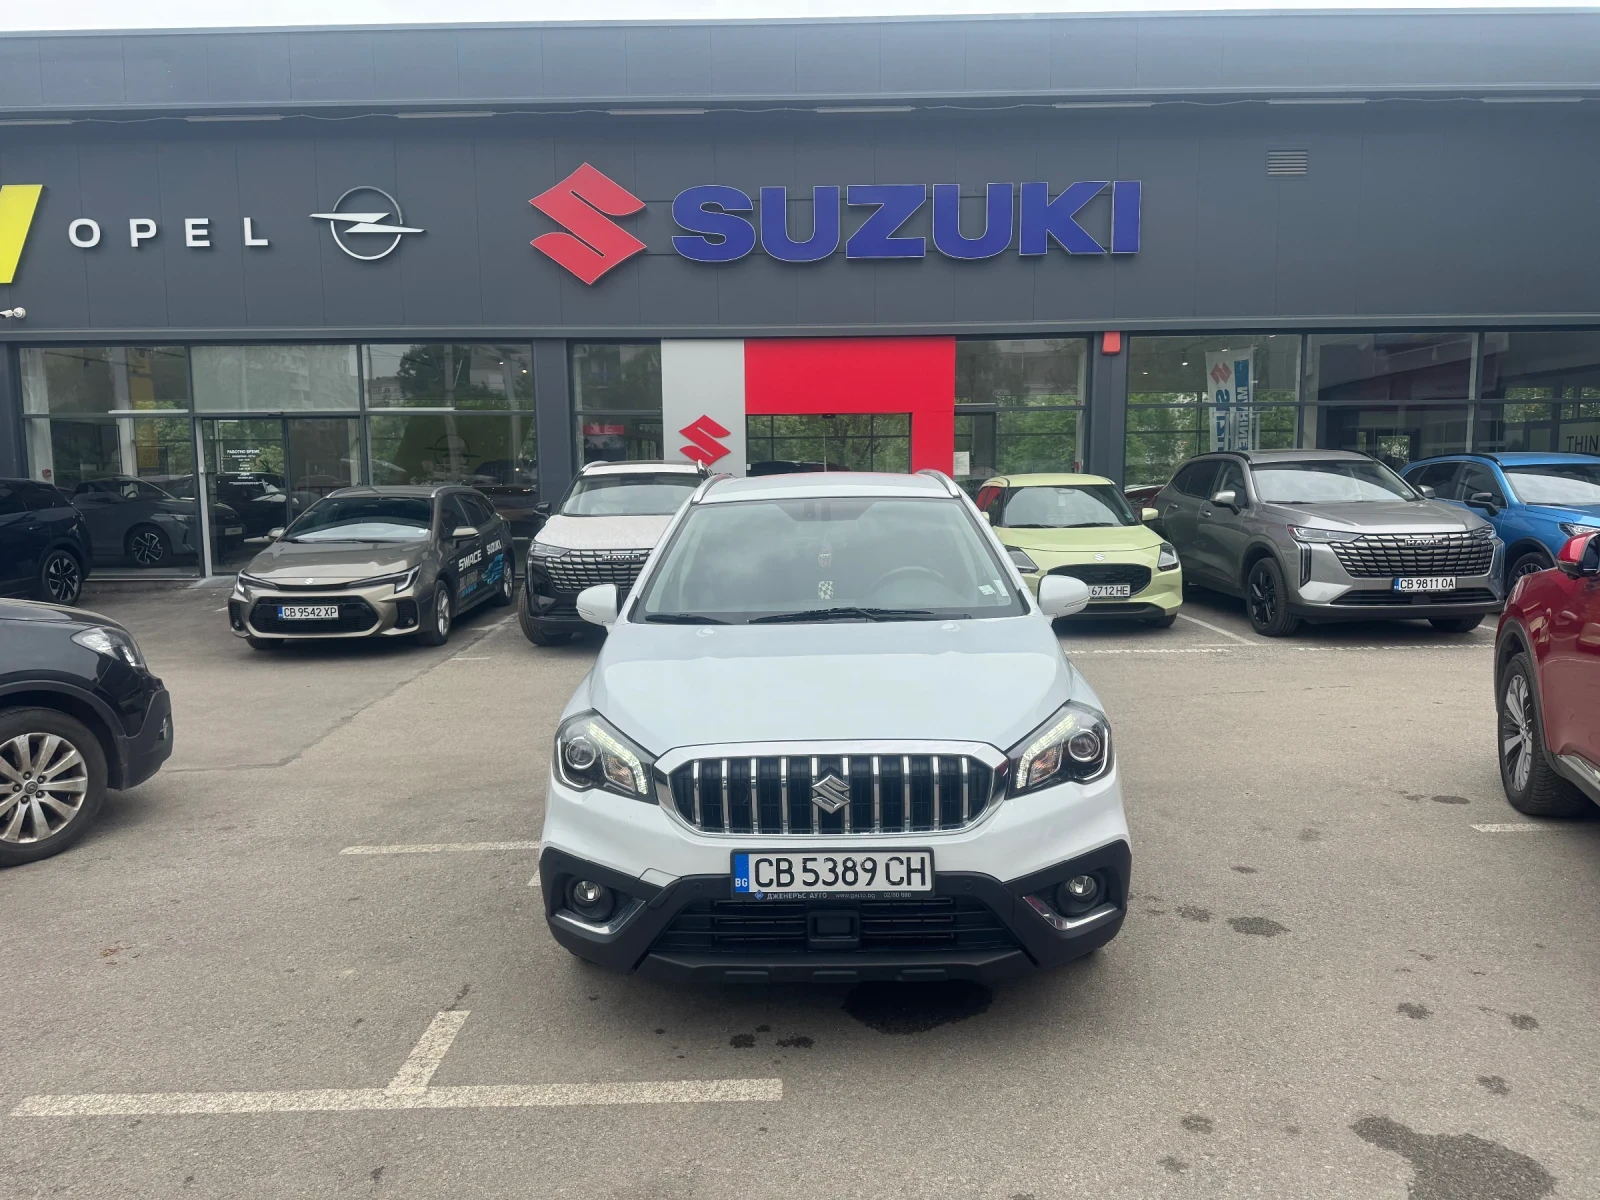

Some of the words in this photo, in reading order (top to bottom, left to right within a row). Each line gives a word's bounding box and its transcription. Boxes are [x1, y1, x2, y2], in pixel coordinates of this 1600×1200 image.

[671, 180, 1141, 262] SUZUKI
[68, 217, 269, 248] OPEL
[458, 549, 482, 572] SWACE
[1091, 586, 1115, 596] 6712
[1116, 585, 1129, 595] HE
[1400, 579, 1413, 589] CB
[1416, 578, 1439, 589] 9811
[1441, 578, 1454, 588] OA
[284, 607, 296, 617] CB
[298, 607, 322, 617] 9542
[324, 607, 337, 617] XP
[754, 857, 795, 888] CB
[802, 857, 878, 887] 5389
[885, 856, 926, 887] CH
[735, 878, 748, 887] BG
